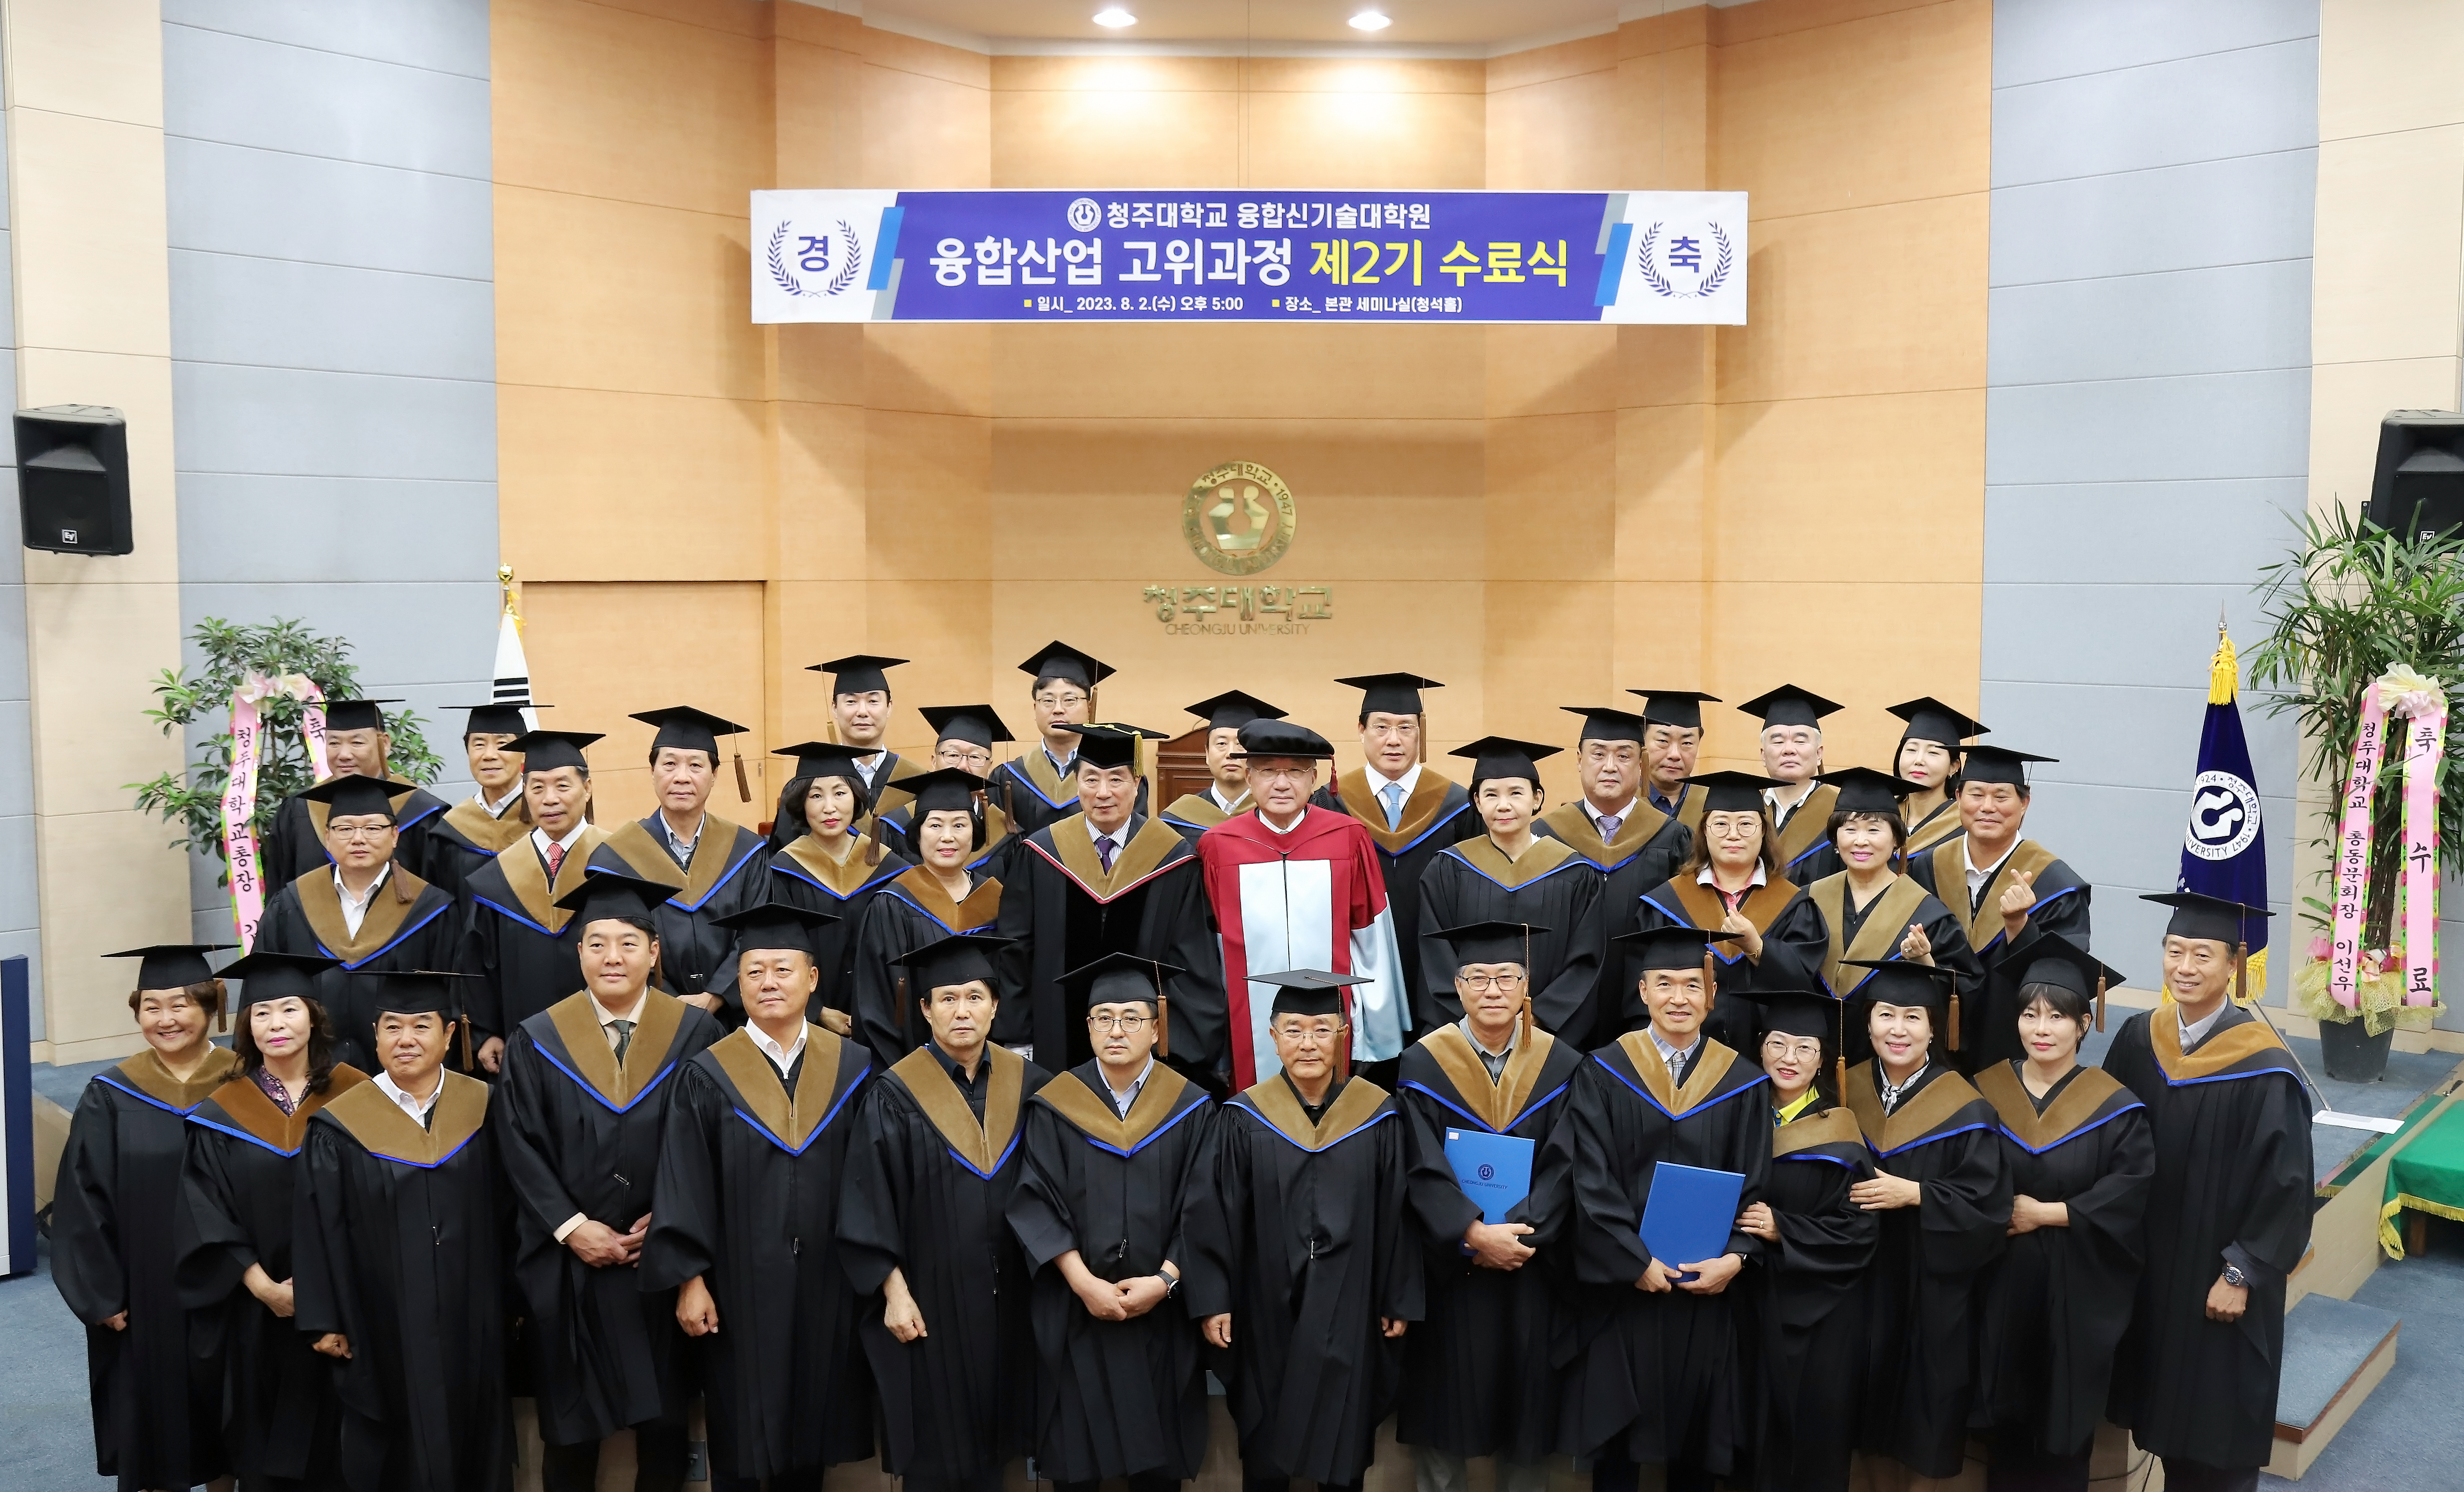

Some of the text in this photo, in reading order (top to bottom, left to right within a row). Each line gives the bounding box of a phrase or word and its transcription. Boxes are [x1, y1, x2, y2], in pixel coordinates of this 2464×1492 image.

[1107, 201, 1228, 228] 청주대학교
[1236, 202, 1431, 229] 융합신기술대학원
[798, 235, 829, 272] 경
[929, 235, 1567, 287] 융합산업 고위과정 제2기 수료식
[1668, 236, 1702, 273] 축
[1076, 297, 1117, 311] 2023.
[1120, 297, 1134, 311] 8.
[1139, 295, 1176, 312] 2.(수)
[1180, 295, 1207, 311] 오후
[1212, 297, 1243, 311] 5:00
[1325, 296, 1353, 312] 본관
[1356, 296, 1462, 313] 세미나실(청석홀)
[1202, 463, 1272, 486] 청주대학교
[1277, 489, 1293, 516] 1947
[1143, 584, 1333, 623] 청주대학교
[1165, 623, 1311, 635] CHEONGJU UNIVERSITY
[2198, 774, 2217, 786] 1924
[2227, 776, 2258, 825] 청주대학교
[2232, 833, 2250, 852] 1947
[2332, 722, 2376, 992] 청주대학교 총동문회장 이선우
[2409, 727, 2437, 993] 축 수 료
